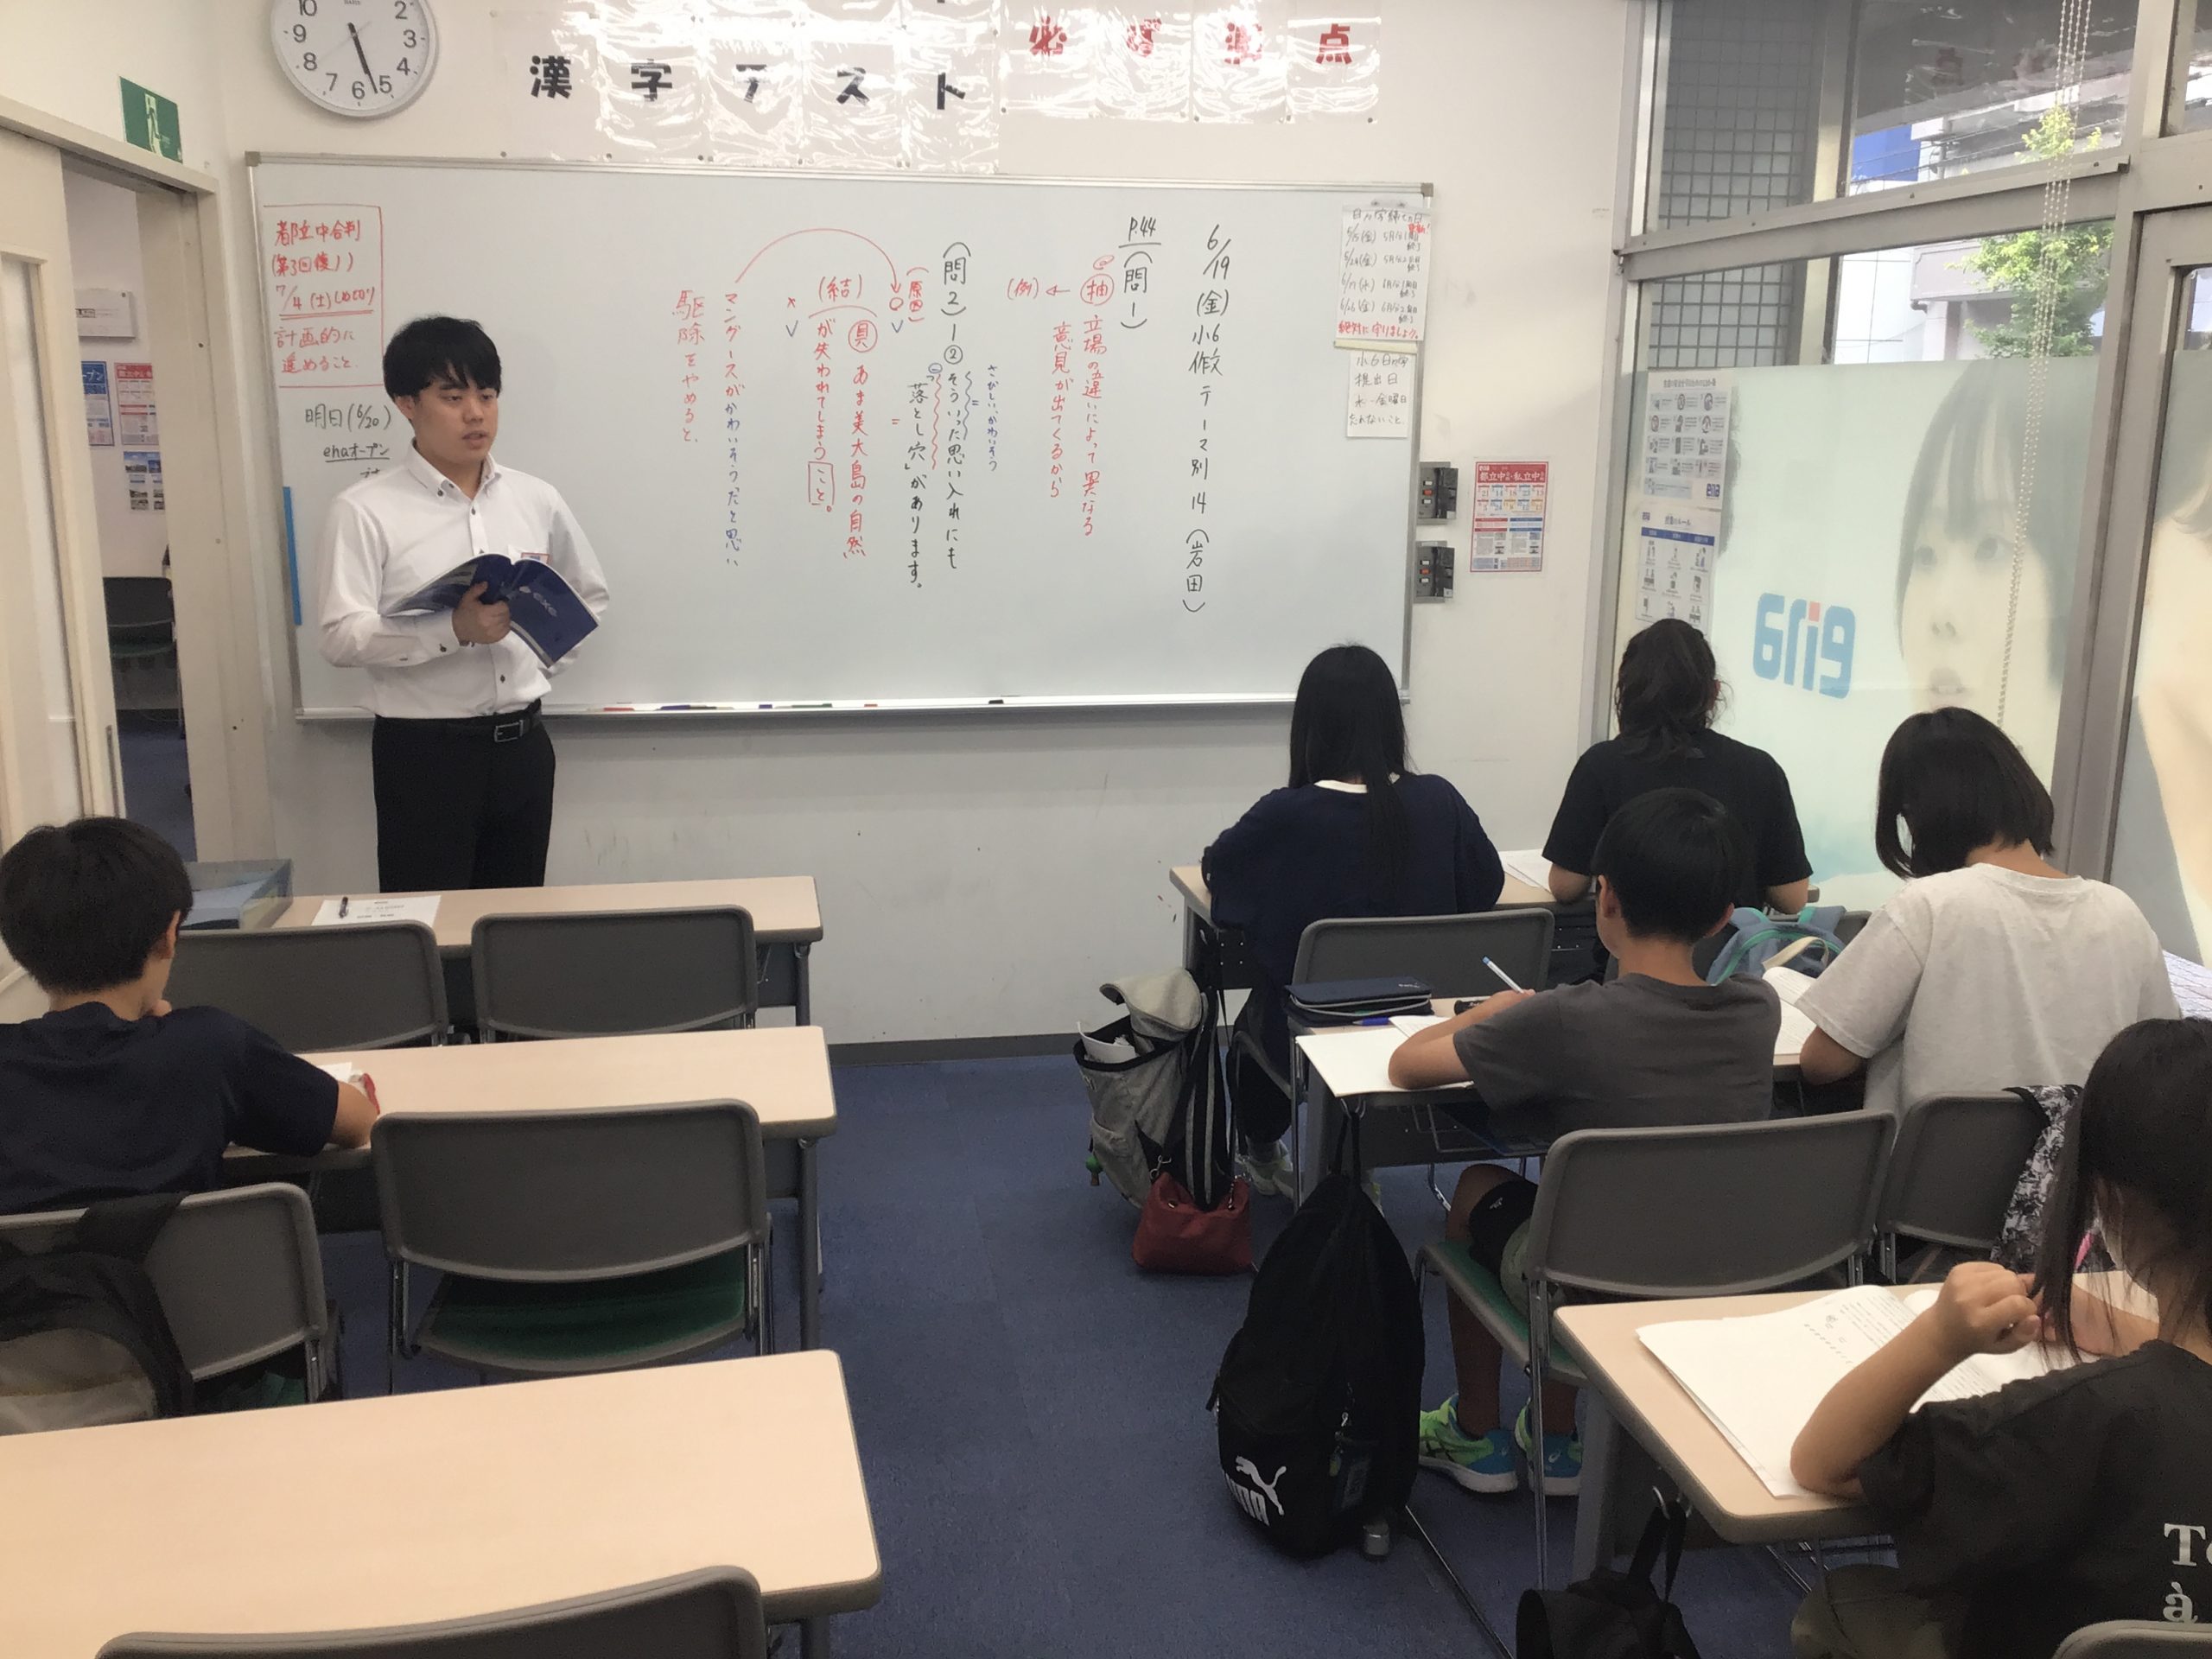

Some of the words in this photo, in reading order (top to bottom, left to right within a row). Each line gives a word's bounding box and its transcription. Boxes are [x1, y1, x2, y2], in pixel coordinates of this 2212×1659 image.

[299, 0, 317, 16] 10
[394, 0, 408, 20] 2
[292, 23, 307, 43] 9
[403, 29, 416, 48] 3
[303, 52, 318, 71] 8
[397, 57, 410, 76] 4
[326, 73, 338, 91] 7
[352, 80, 365, 99] 6
[379, 74, 392, 93] 5
[2163, 1581, 2198, 1623] à
